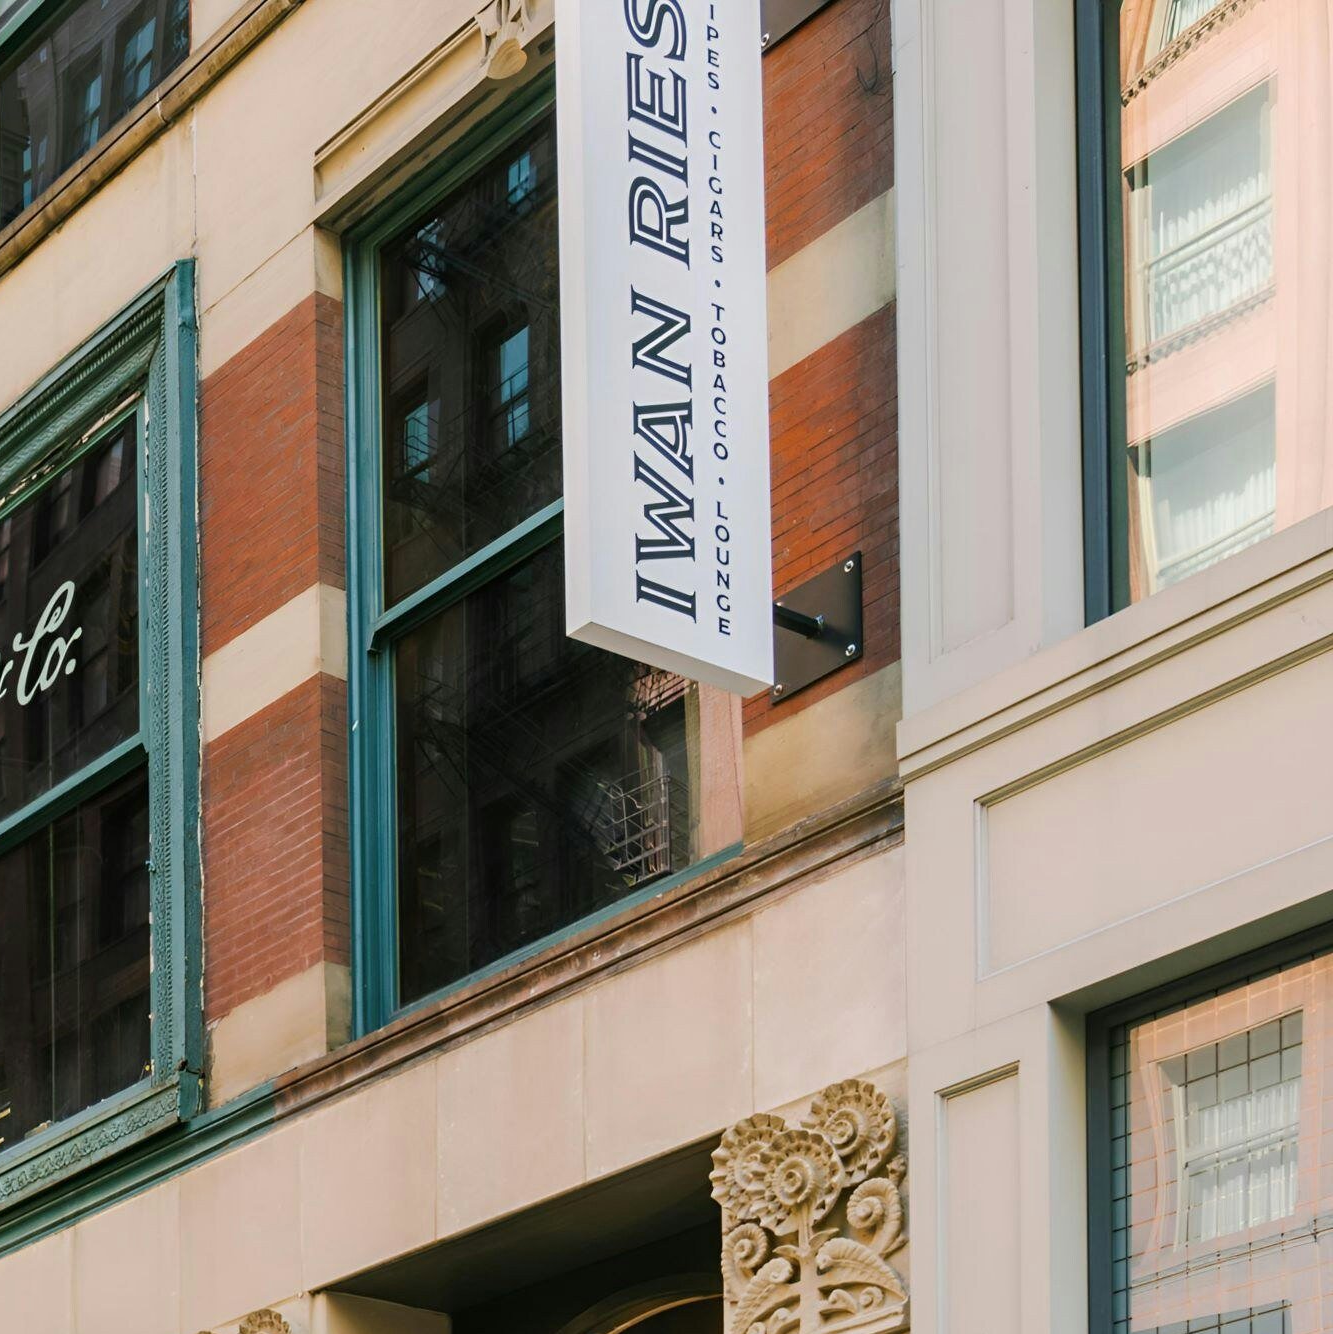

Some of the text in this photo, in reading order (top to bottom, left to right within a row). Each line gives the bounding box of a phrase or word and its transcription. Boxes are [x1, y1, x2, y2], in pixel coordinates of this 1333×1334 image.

[623, 0, 697, 624] IWAN RIES
[706, 3, 732, 636] IPES CIGARS TOBACCO LOUNGE
